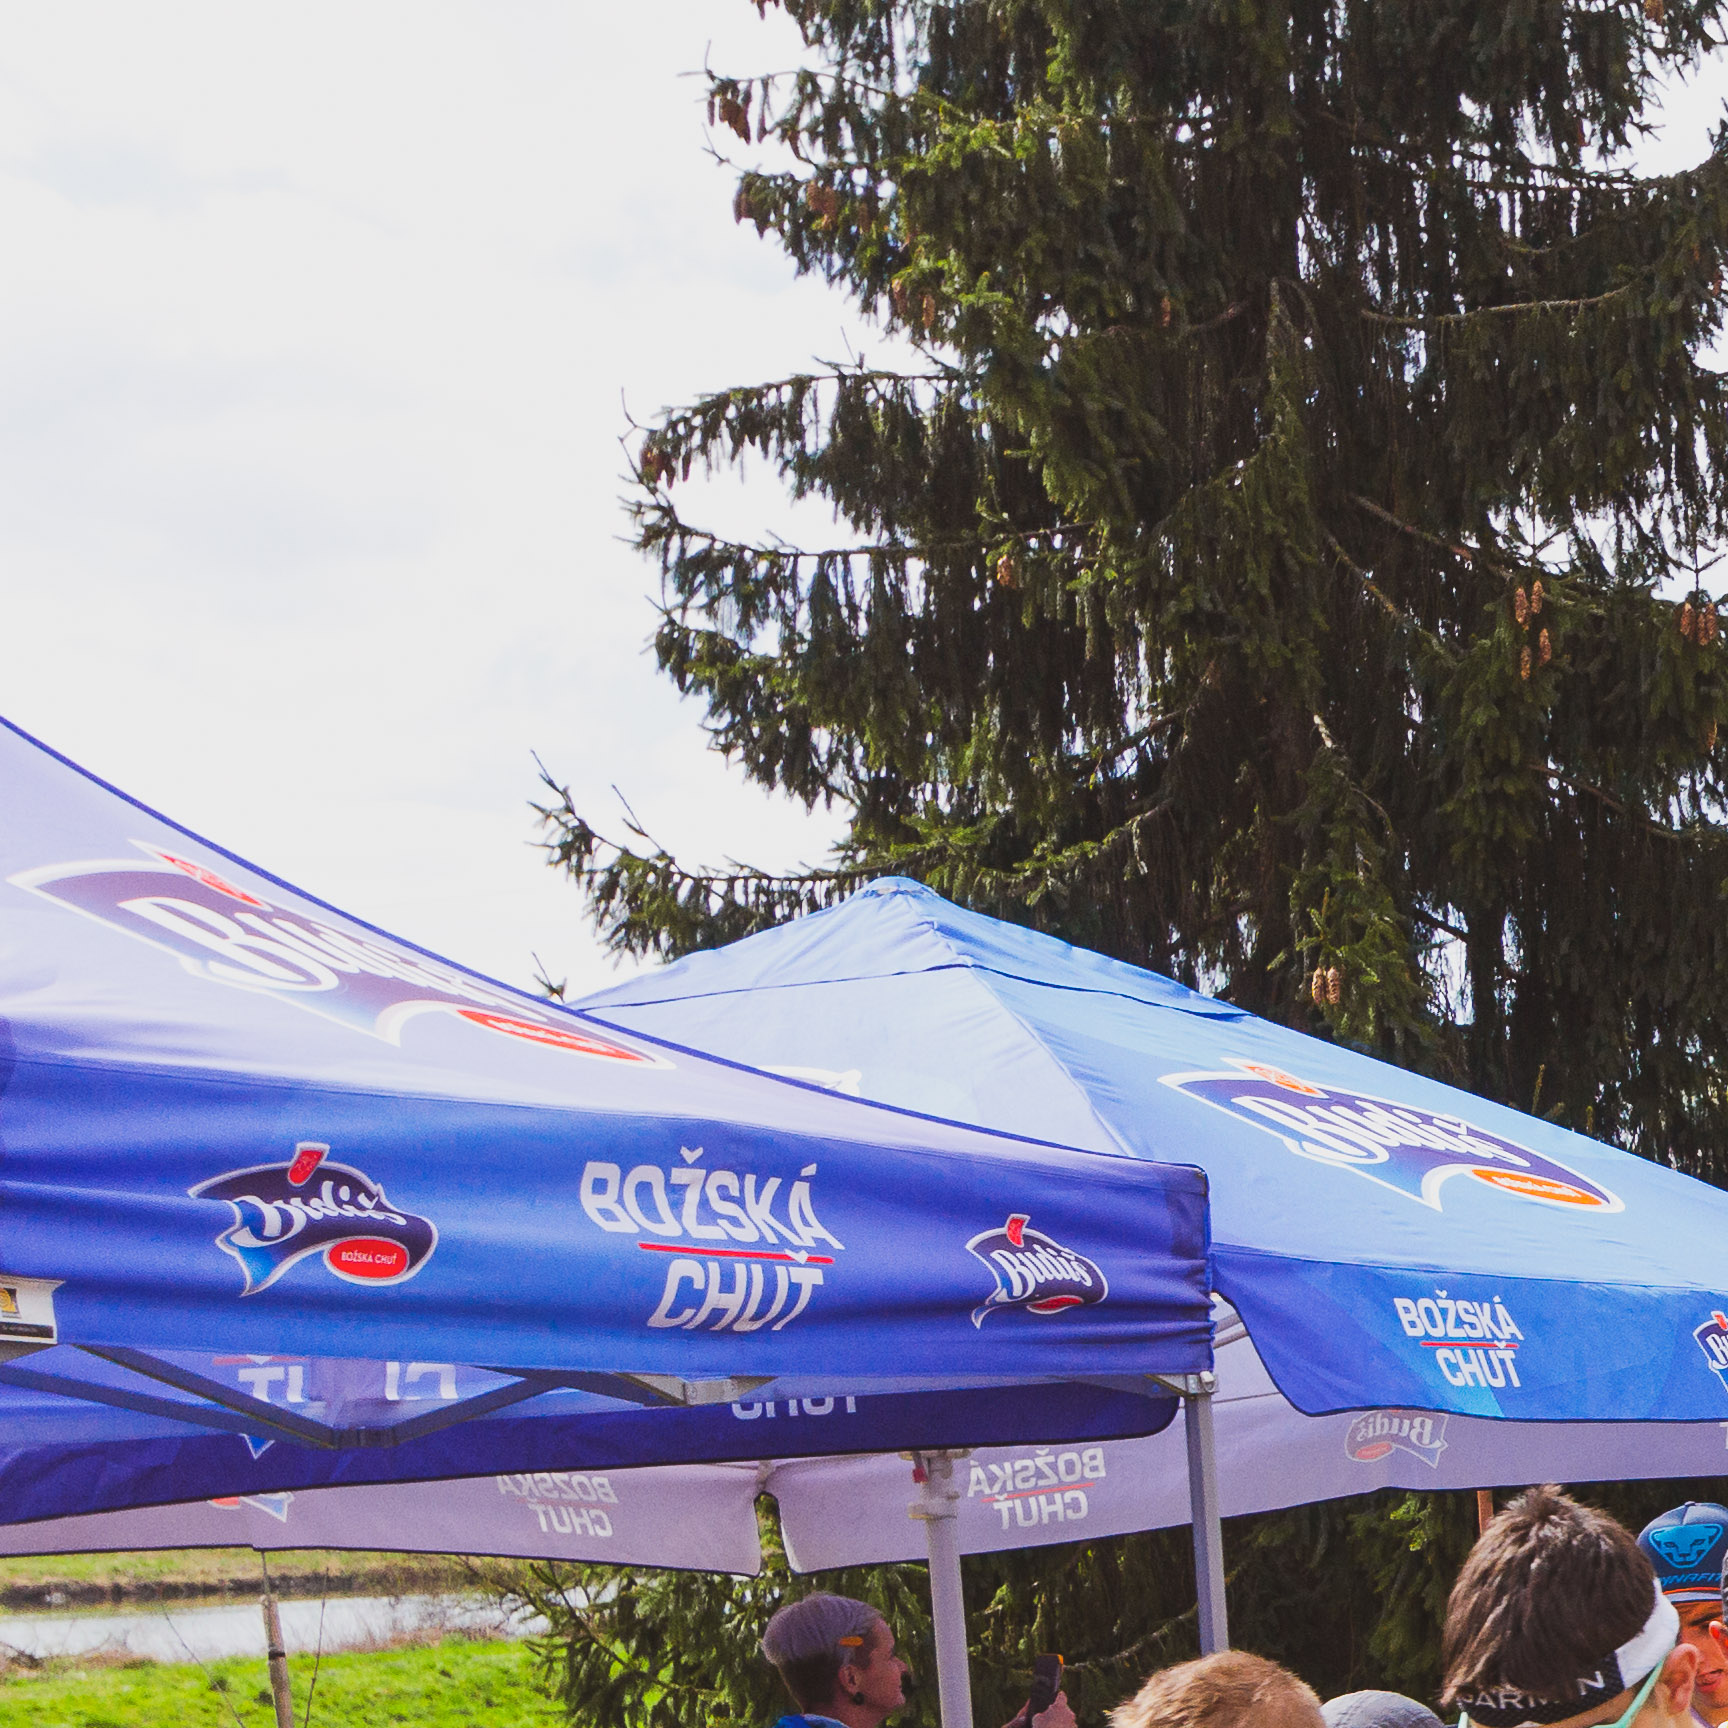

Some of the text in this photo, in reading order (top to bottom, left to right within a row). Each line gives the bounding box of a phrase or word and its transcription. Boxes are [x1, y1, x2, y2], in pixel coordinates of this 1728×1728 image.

[580, 1146, 845, 1250] BOŽSKÁ
[341, 1249, 373, 1263] BOŽSKÁ
[647, 1249, 824, 1332] CHUŤ
[1394, 1290, 1524, 1341] BOŽSKÁ
[1436, 1340, 1522, 1388] CHUŤ
[1660, 1572, 1722, 1587] YNAFIT
